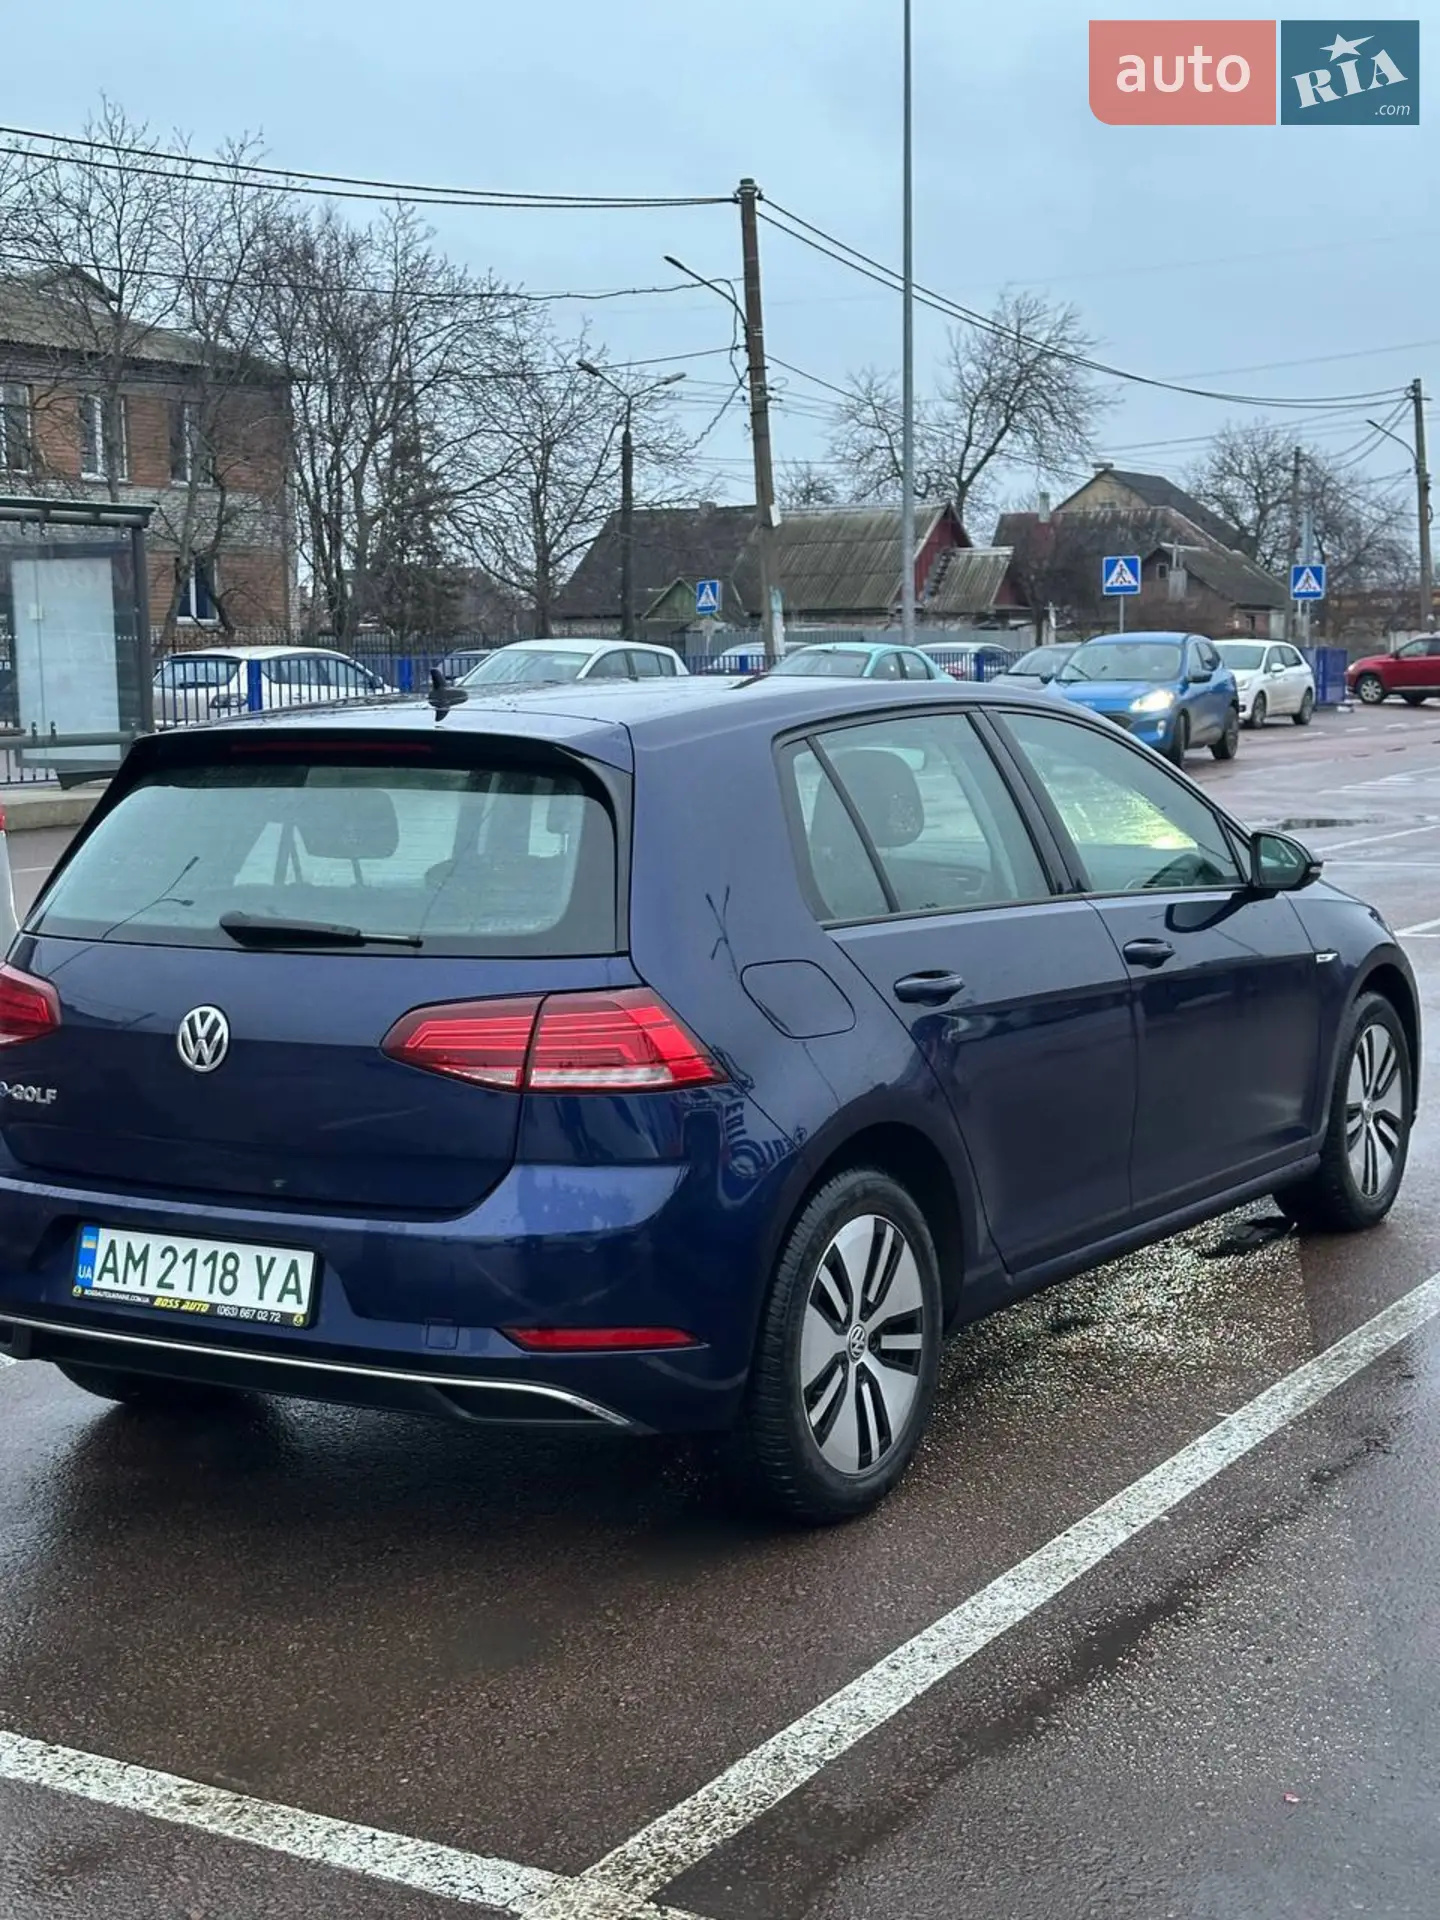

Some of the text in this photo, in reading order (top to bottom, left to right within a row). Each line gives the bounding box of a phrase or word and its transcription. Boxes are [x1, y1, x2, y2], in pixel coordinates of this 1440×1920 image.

[78, 1265, 93, 1279] UA
[97, 1239, 303, 1305] AM 2118 YA
[153, 1297, 210, 1313] BOSS AUTO
